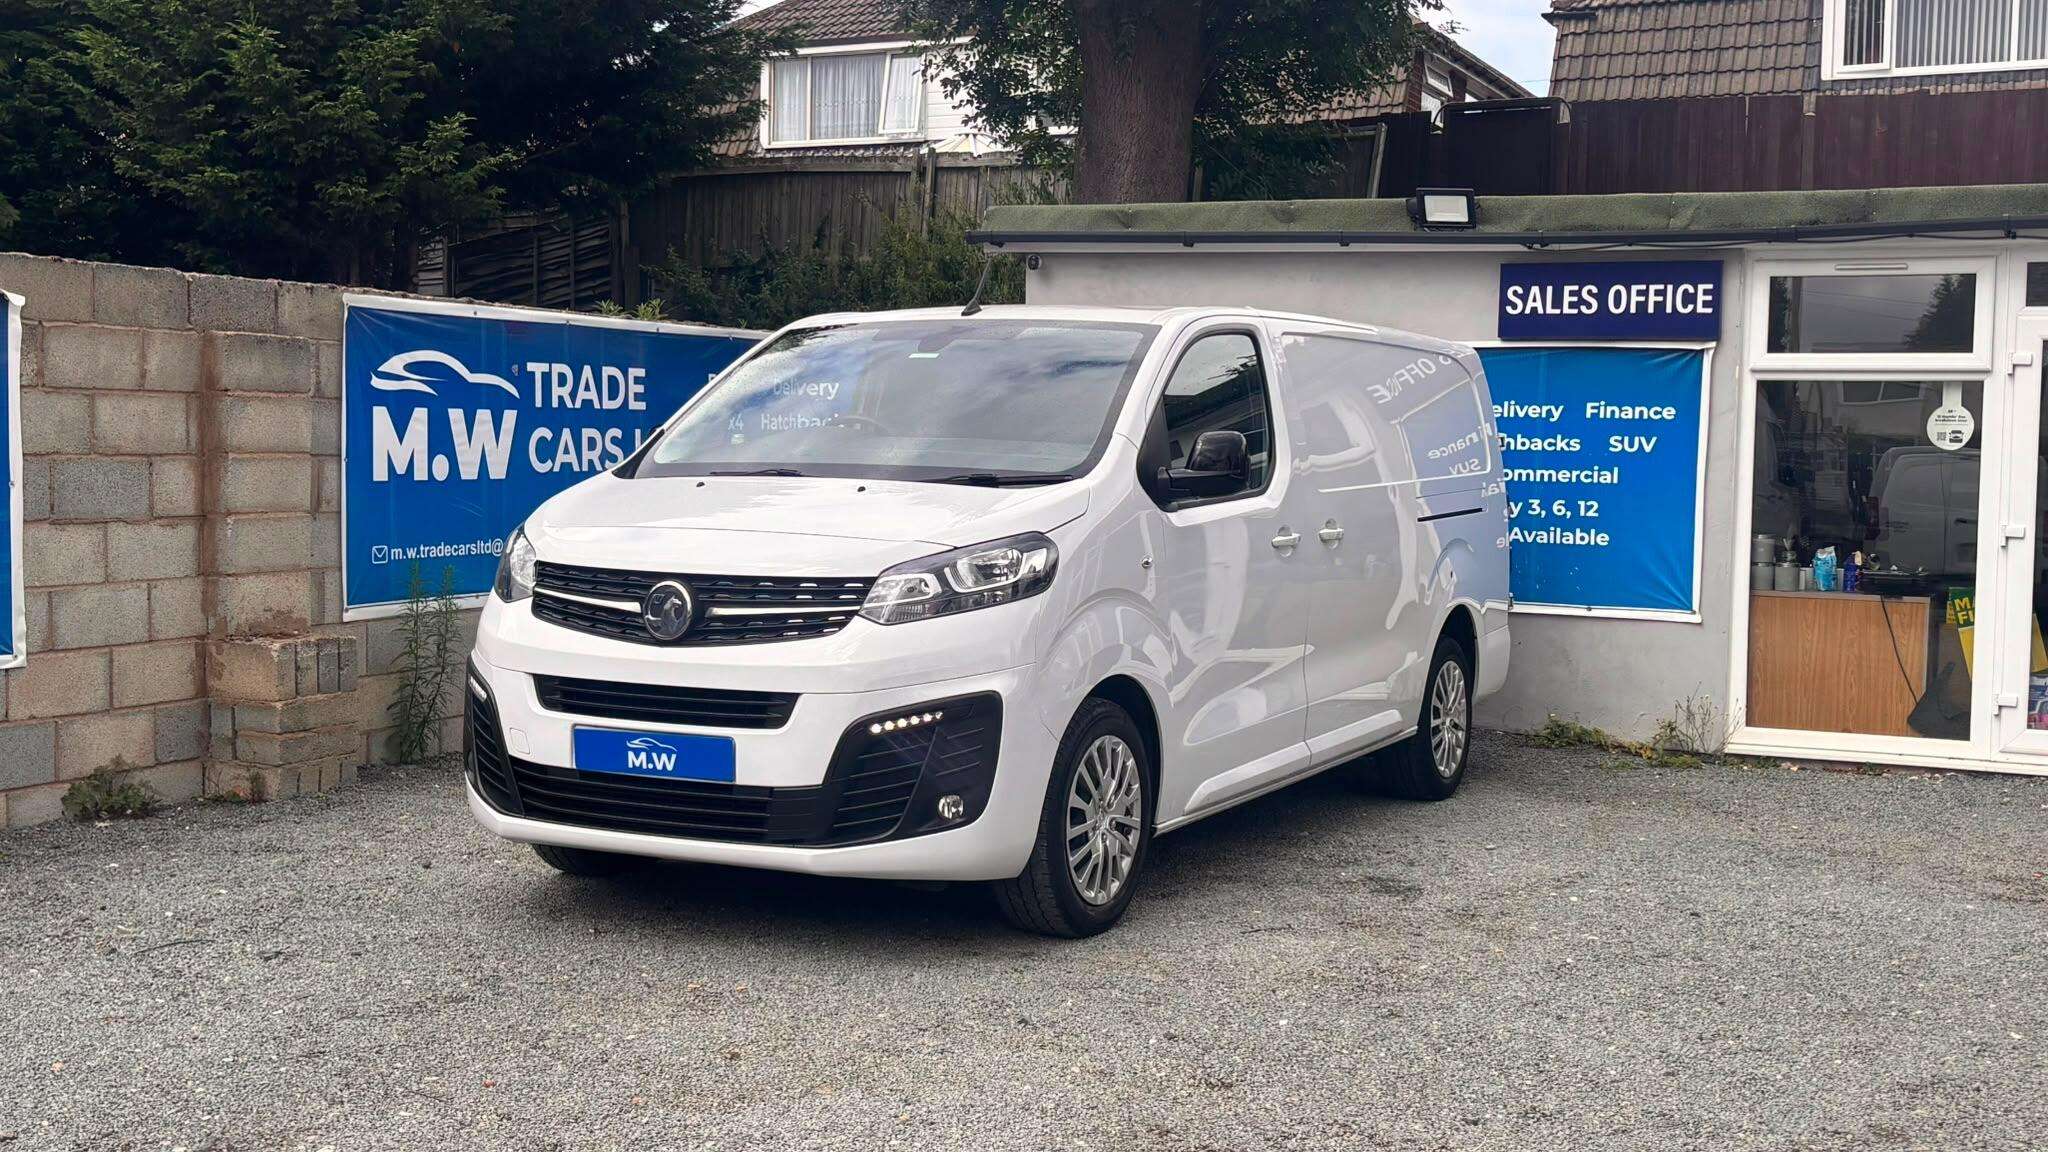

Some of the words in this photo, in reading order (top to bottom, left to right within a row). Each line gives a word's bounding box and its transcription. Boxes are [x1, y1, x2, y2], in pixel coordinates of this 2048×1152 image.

[1505, 285, 1599, 315] SALES
[1607, 283, 1714, 314] OFFICE
[526, 362, 647, 411] TRADE
[1492, 400, 1564, 422] elivery
[1586, 400, 1676, 420] Finance
[727, 413, 745, 431] x4
[371, 406, 518, 482] M.W
[528, 427, 624, 473] CARS
[1500, 433, 1581, 452] hbacks
[1608, 435, 1658, 453] SUV
[1503, 465, 1619, 484] ommercial
[1528, 499, 1547, 519] 3,
[1552, 500, 1572, 519] 6,
[1577, 500, 1599, 517] 12
[1509, 526, 1610, 546] Available
[390, 538, 504, 560] m.w.tradecarsltd@
[627, 750, 677, 771] M.W
